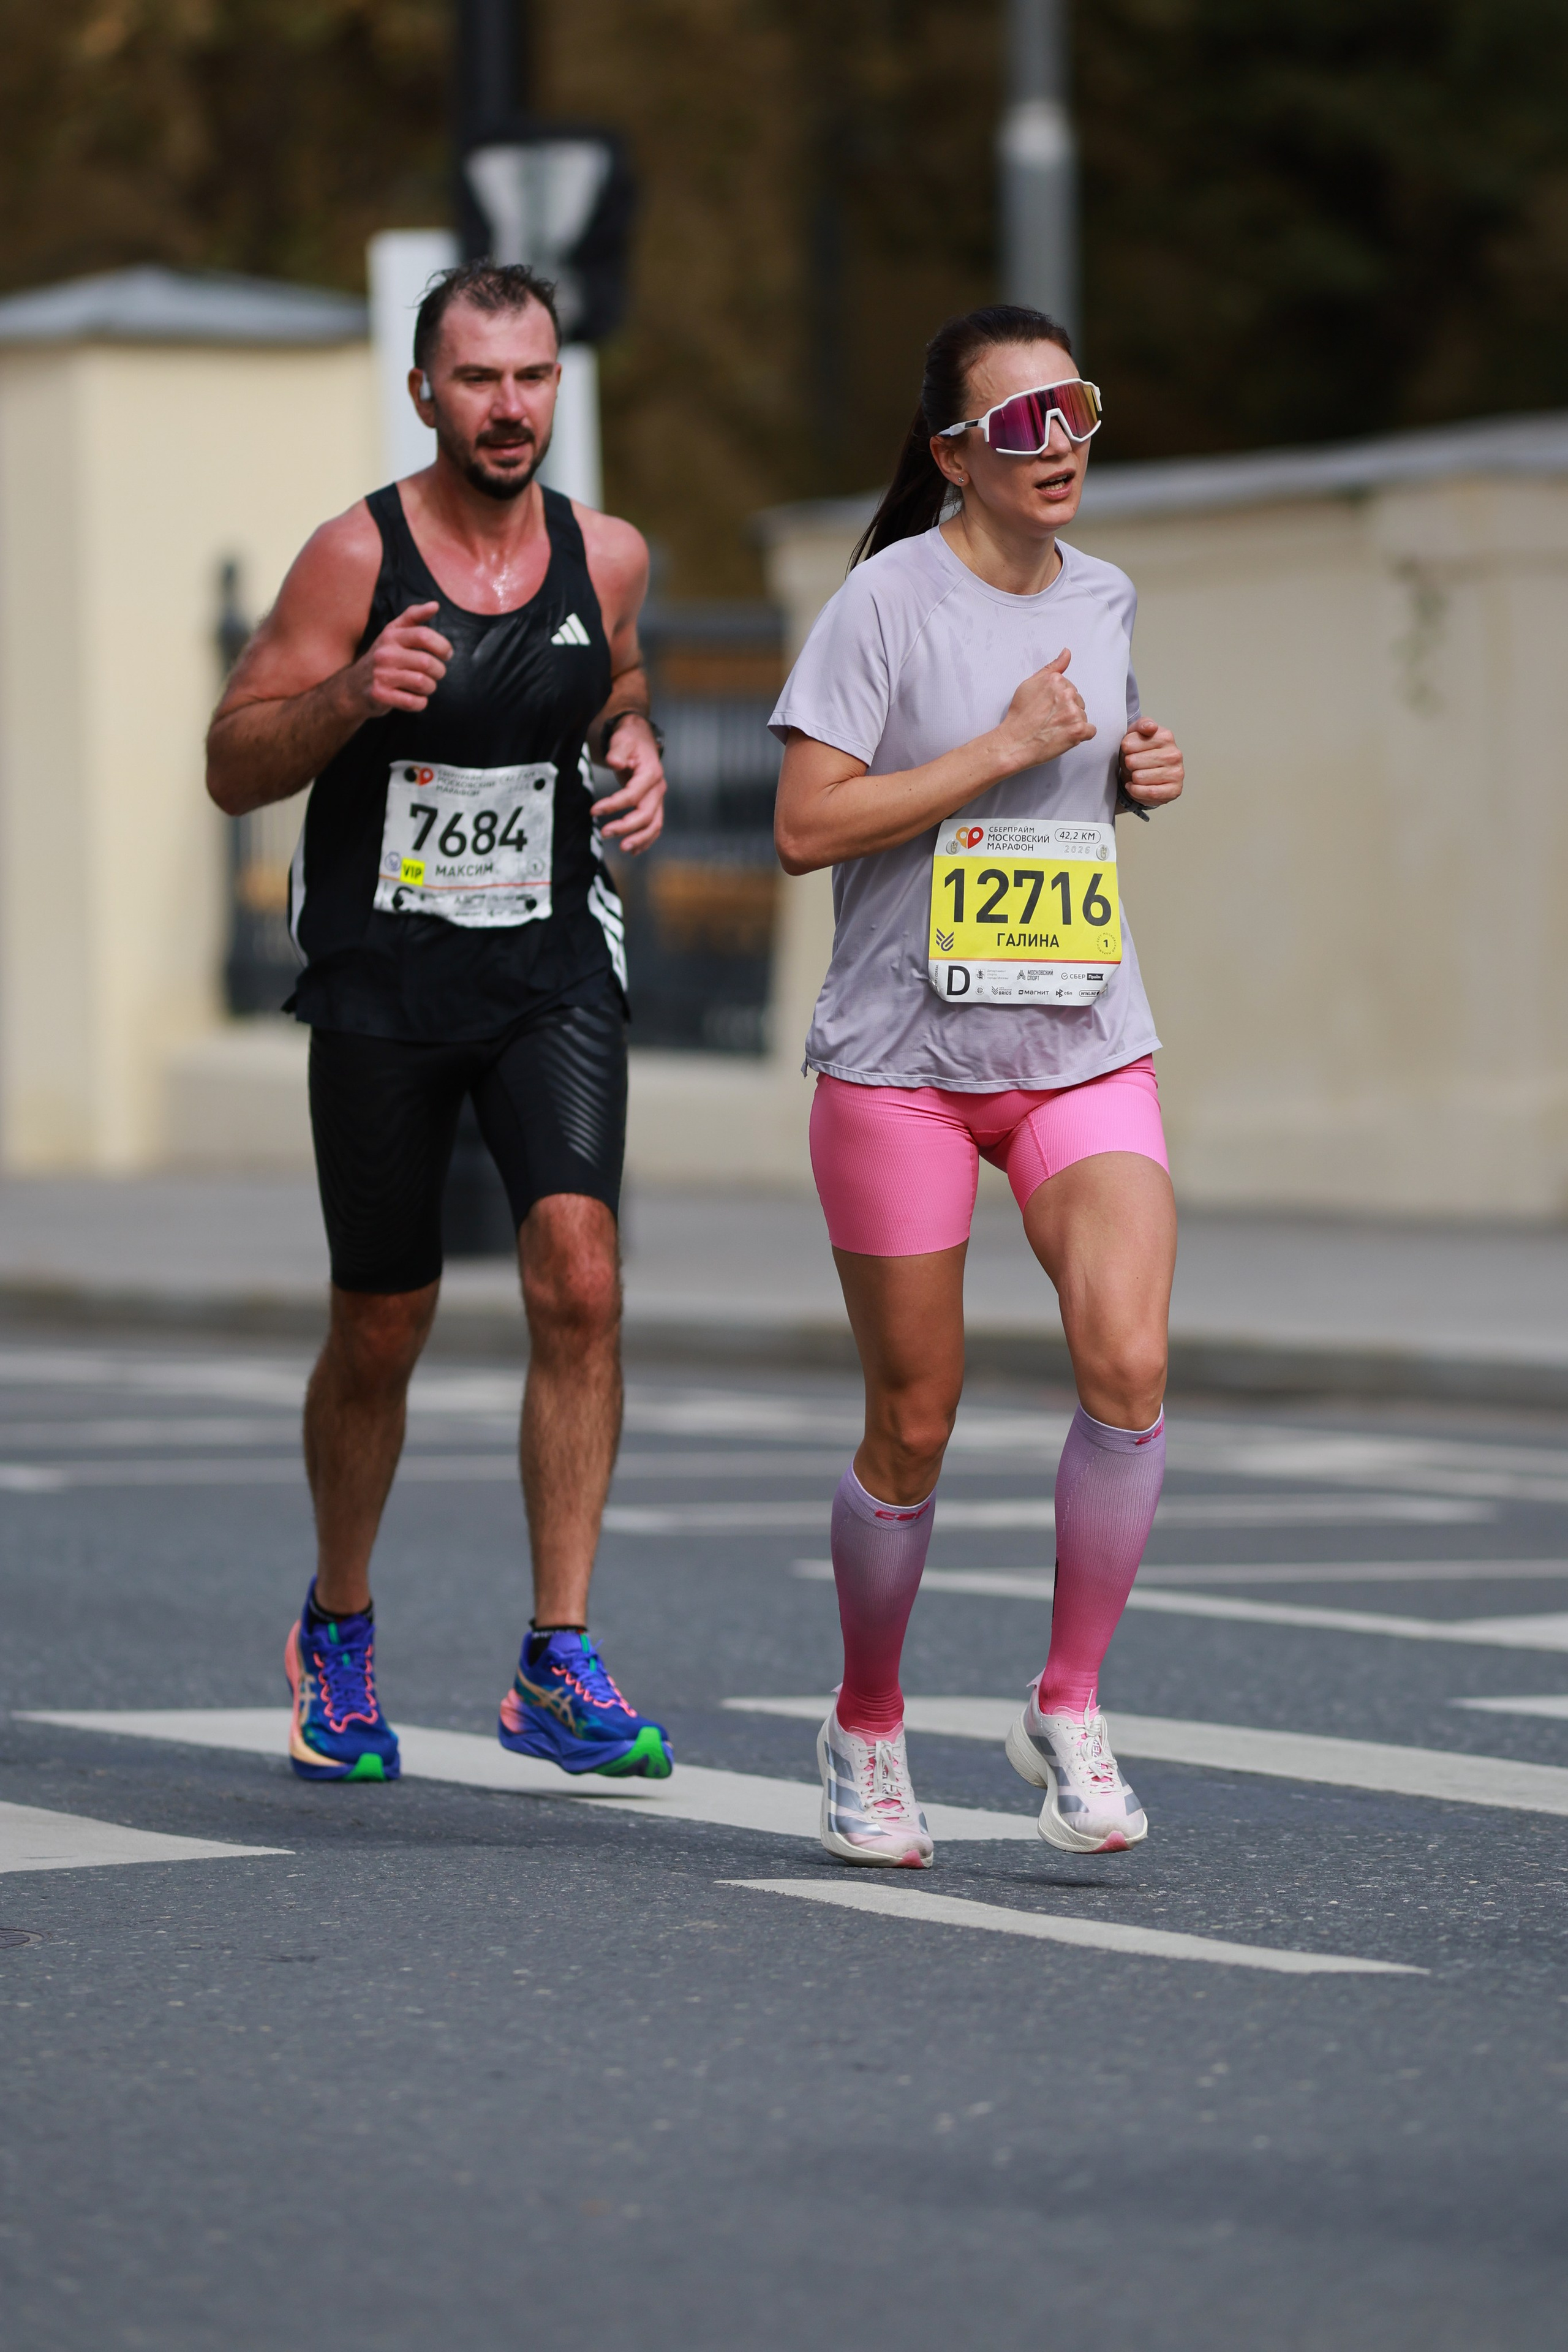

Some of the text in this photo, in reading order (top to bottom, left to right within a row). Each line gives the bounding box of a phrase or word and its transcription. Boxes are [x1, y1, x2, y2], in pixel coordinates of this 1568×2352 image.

[410, 803, 528, 858] 7684
[1060, 831, 1079, 840] 42,2
[988, 834, 1050, 843] МОСКОВСКИЙ
[987, 843, 1034, 851] МАРАФОН
[1064, 845, 1090, 854] 2026
[402, 864, 422, 880] VIP
[435, 863, 494, 877] МАКСИМ
[944, 868, 1112, 927] 12716
[997, 933, 1060, 948] ГАЛИНА
[1103, 939, 1108, 948] 1
[947, 965, 971, 996] D
